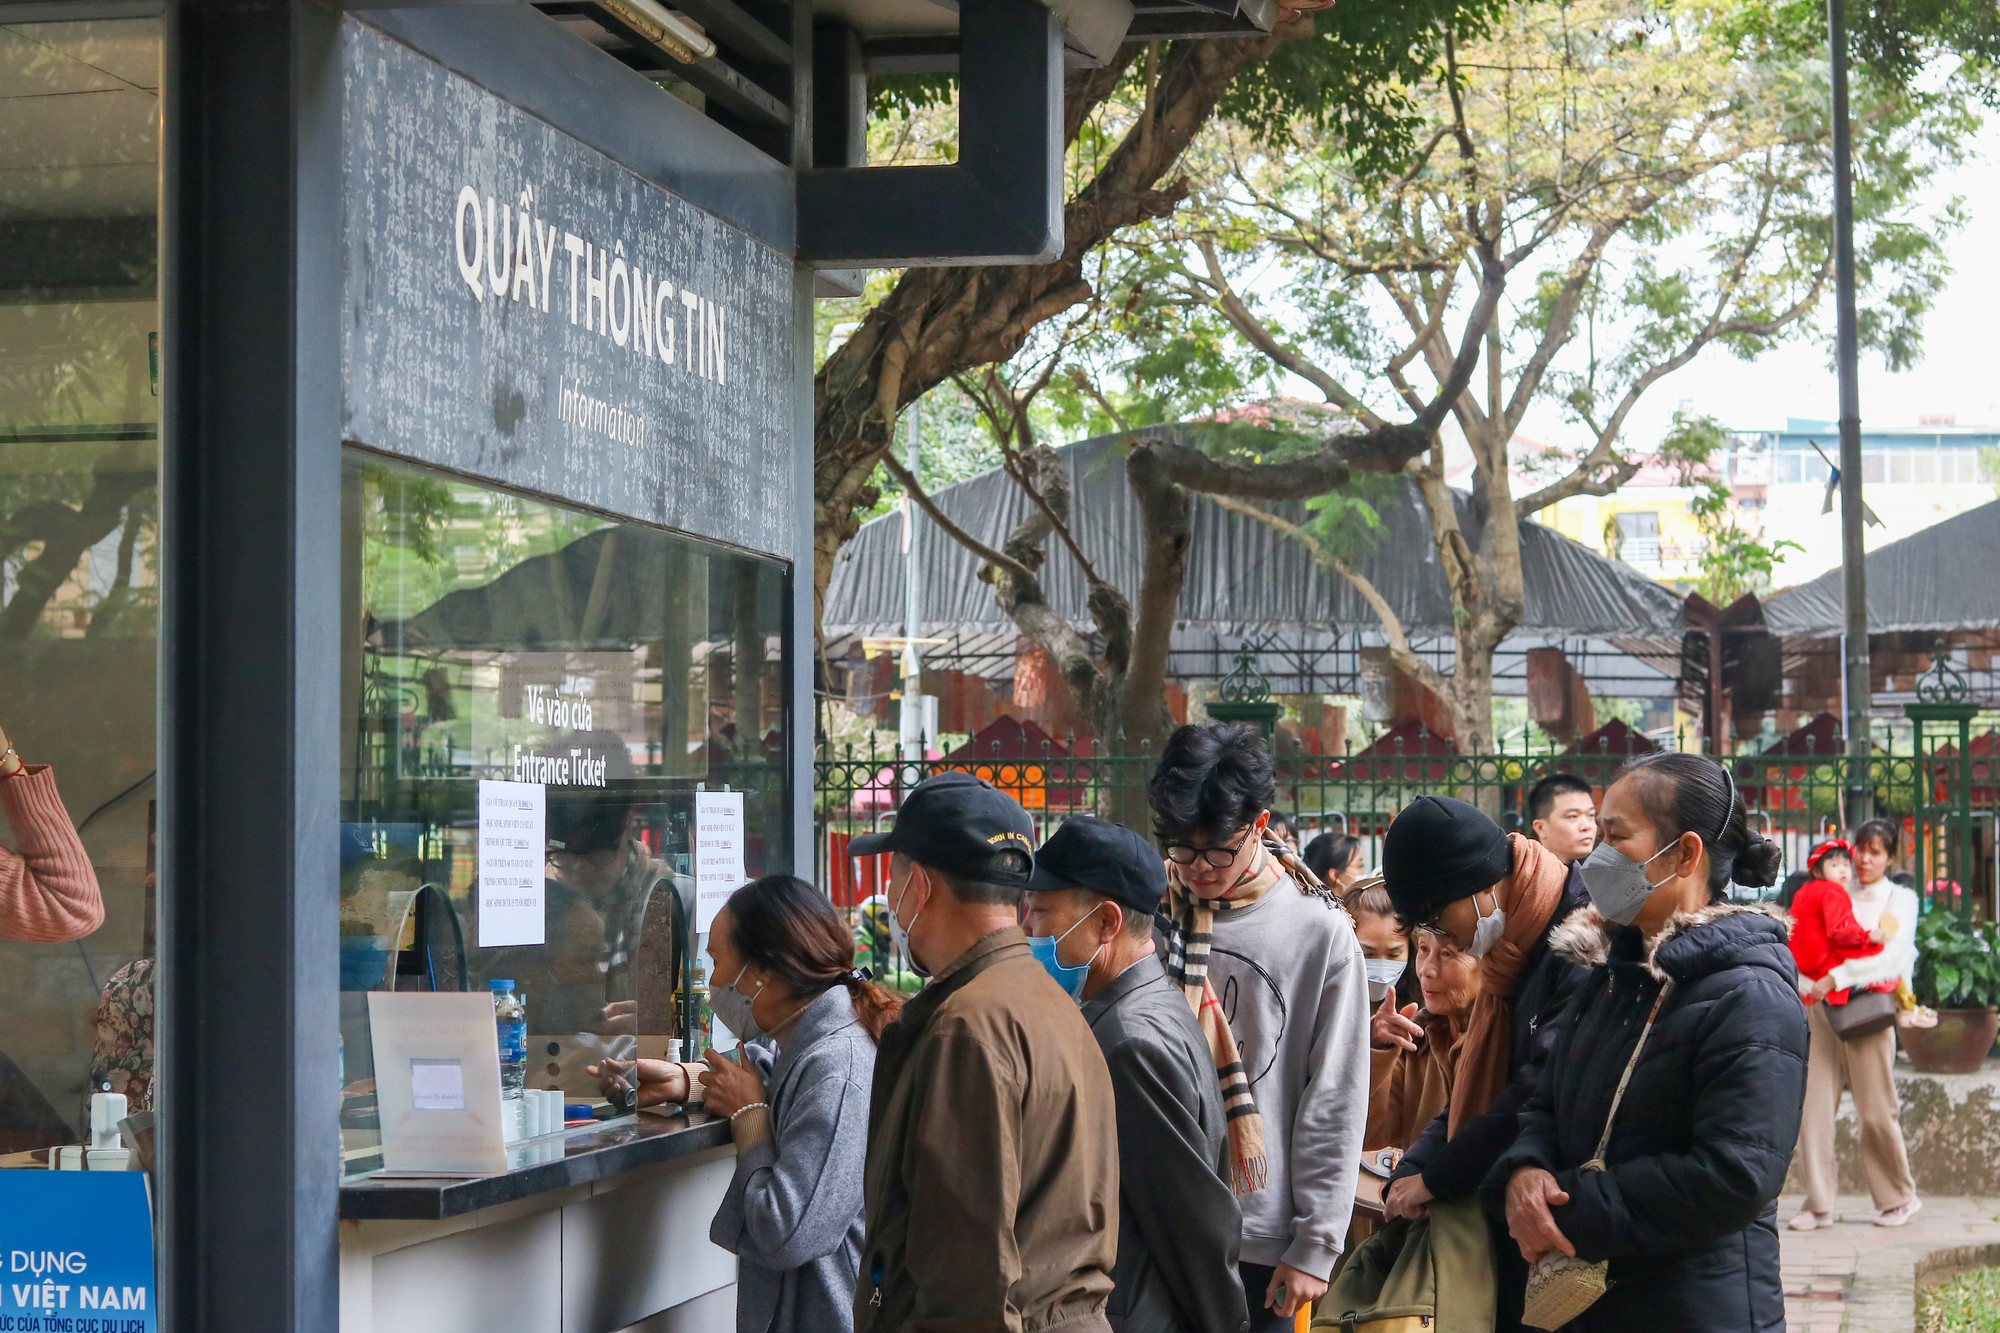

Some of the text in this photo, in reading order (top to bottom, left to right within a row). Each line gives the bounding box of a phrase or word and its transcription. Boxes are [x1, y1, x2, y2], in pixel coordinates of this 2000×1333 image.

[455, 184, 557, 313] QUẦY
[564, 231, 675, 365] THÔNG
[681, 288, 726, 387] TIN
[557, 374, 645, 450] Information
[527, 685, 593, 732] Vé vào cửa
[514, 744, 607, 788] Entrance Ticket
[986, 832, 1006, 845] BORN
[1007, 832, 1015, 840] IN
[11, 1250, 87, 1278] DỤNG
[11, 1278, 70, 1316] VIỆT
[79, 1285, 146, 1311] NAM
[17, 1312, 40, 1332] CỦA
[43, 1311, 73, 1333] TỔNG
